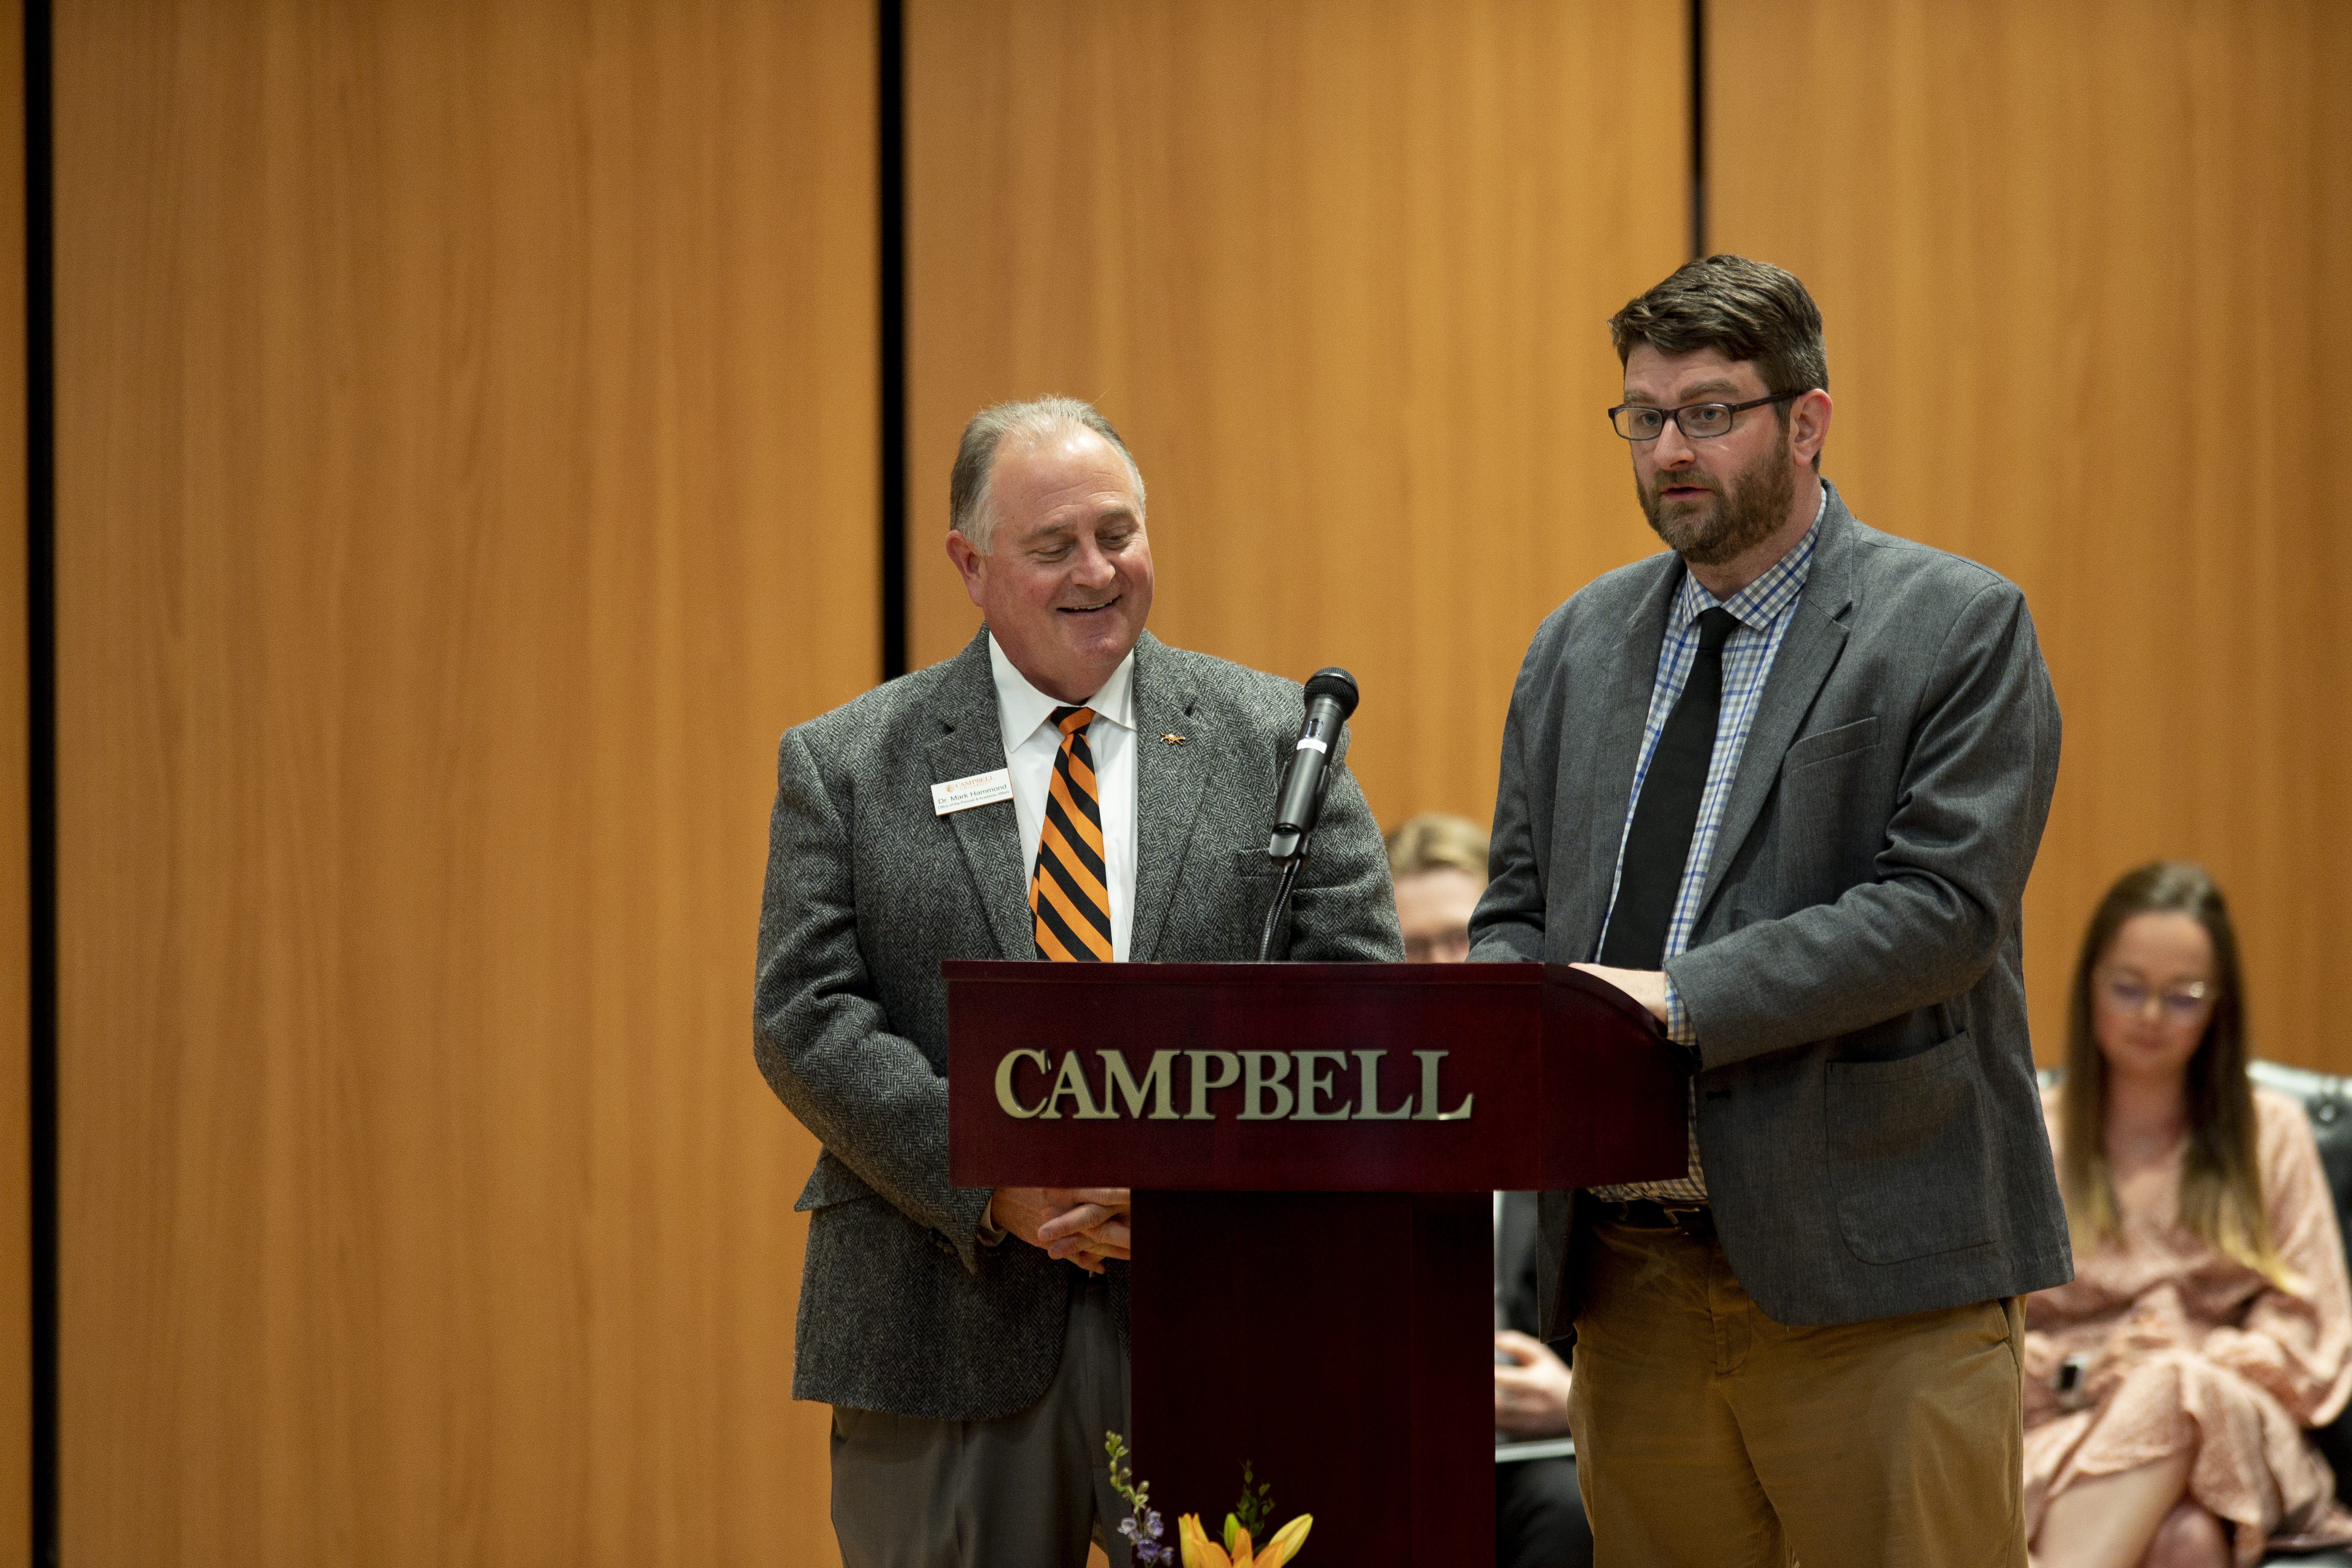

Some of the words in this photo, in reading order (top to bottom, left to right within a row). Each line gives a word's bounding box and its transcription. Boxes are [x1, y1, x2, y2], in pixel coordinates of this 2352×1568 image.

[956, 775, 995, 788] CAMPBELL
[960, 781, 991, 790] UNIVERSITY
[950, 793, 968, 801] Mark
[970, 784, 1007, 797] Hammond
[994, 1048, 1473, 1121] CAMPBELL
